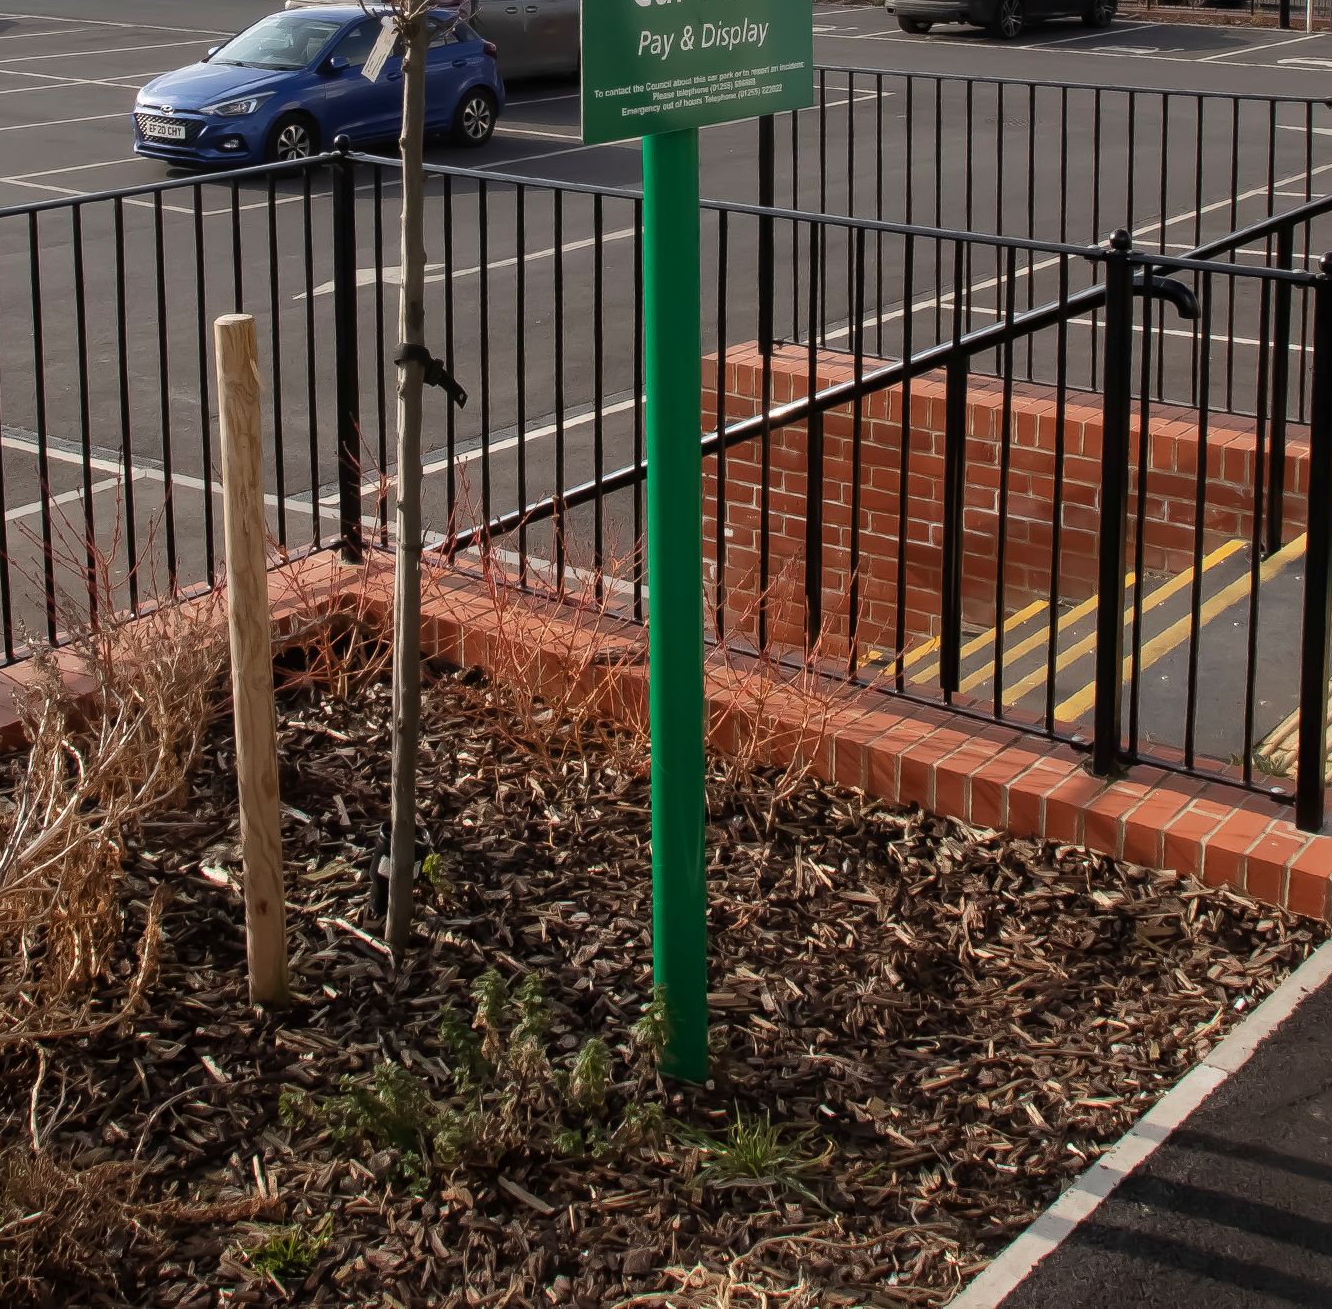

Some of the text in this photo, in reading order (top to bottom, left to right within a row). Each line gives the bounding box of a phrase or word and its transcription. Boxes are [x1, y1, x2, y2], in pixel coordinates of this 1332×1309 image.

[638, 18, 770, 61] Pay & Display
[594, 90, 603, 98] To
[605, 86, 631, 96] contact
[633, 84, 644, 92] the
[646, 80, 671, 91] Council
[673, 78, 692, 87] about
[719, 71, 733, 81] park
[653, 91, 675, 100] Please
[676, 86, 708, 97] telephone
[622, 104, 660, 116] Emergency
[663, 102, 673, 110] out
[675, 100, 683, 108] of
[684, 97, 702, 106] hours
[705, 92, 736, 103] Telephone
